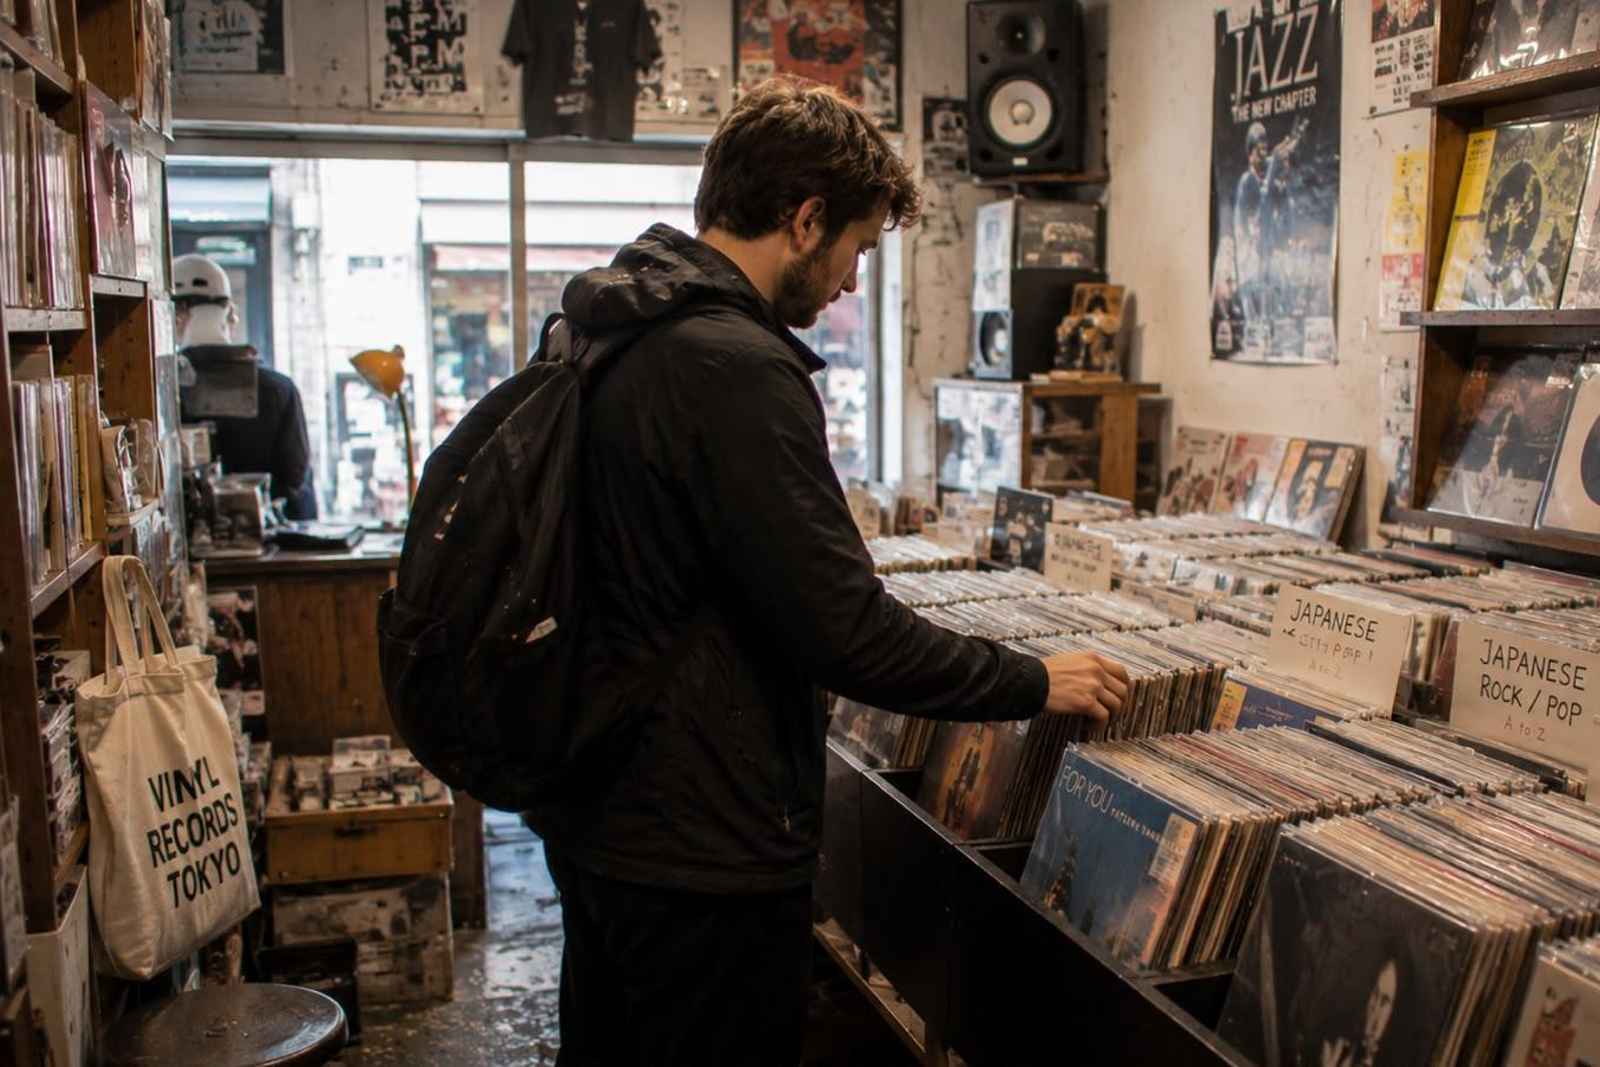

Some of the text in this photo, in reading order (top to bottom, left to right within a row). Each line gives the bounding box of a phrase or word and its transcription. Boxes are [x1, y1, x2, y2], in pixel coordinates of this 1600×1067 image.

[1230, 4, 1319, 105] JAZZ
[1230, 85, 1317, 123] THE NEW CHAPTER
[1290, 599, 1378, 643] JAPANESE
[1480, 638, 1587, 691] JAPANESE
[1480, 673, 1524, 708] ROCK
[1546, 695, 1583, 726] POP
[1503, 714, 1513, 731] A
[1519, 722, 1532, 736] to
[148, 756, 220, 813] VINYL
[1059, 765, 1087, 800] FOR
[1084, 783, 1114, 814] YOU
[147, 792, 239, 868] RECORDS
[167, 841, 241, 909] TOKYO
